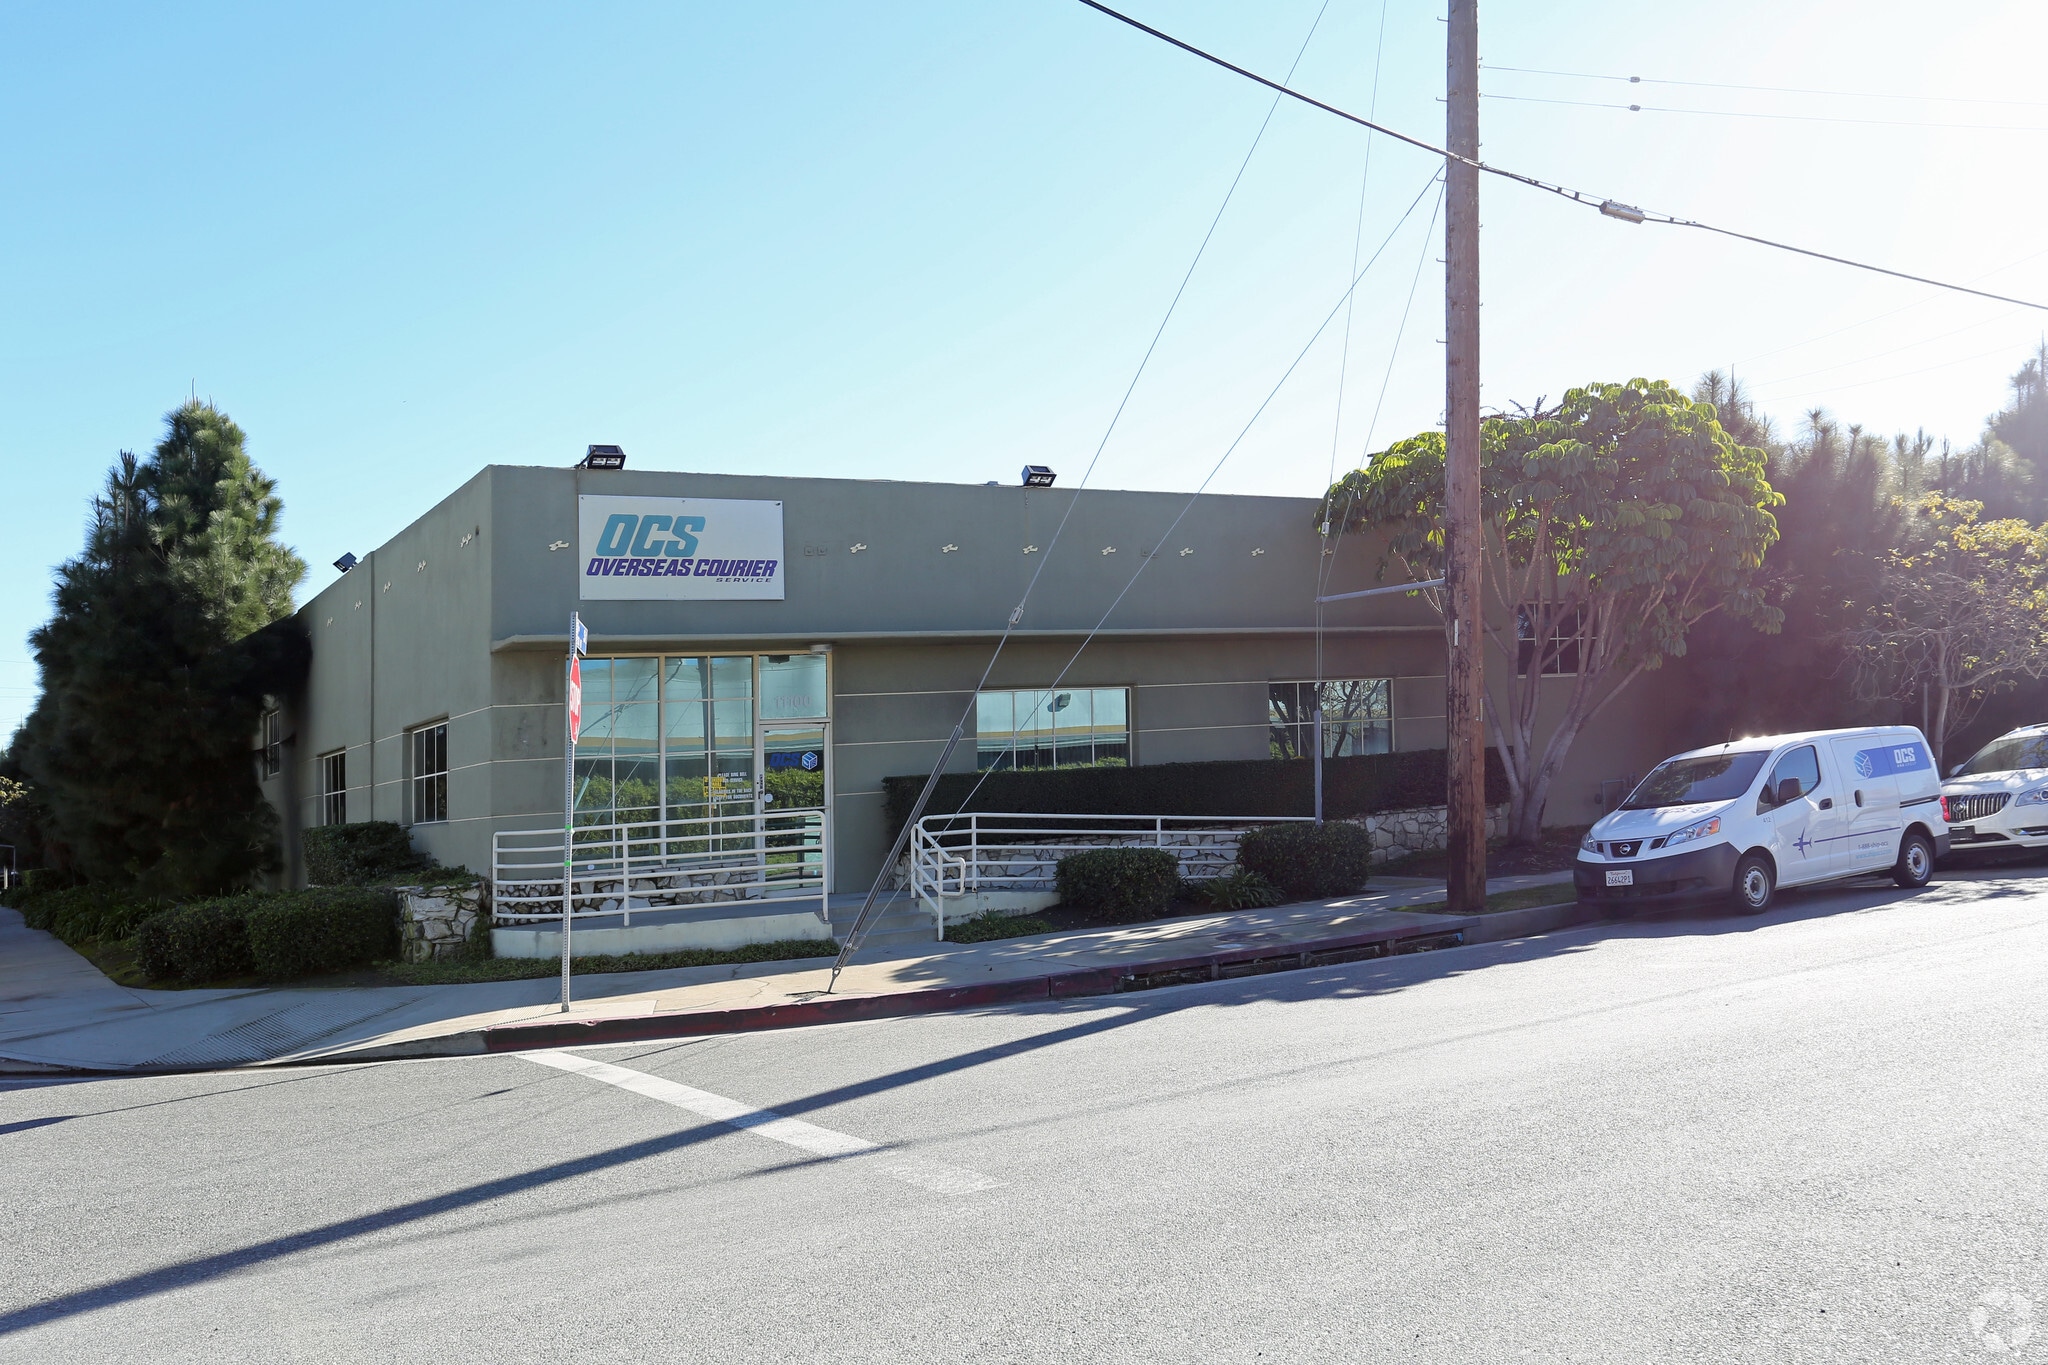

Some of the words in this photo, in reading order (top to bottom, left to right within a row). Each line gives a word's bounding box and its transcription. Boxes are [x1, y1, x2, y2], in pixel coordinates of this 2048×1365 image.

[596, 514, 706, 557] OCS
[586, 558, 694, 577] OVERSEAS
[693, 559, 778, 577] COURIER
[769, 752, 801, 767] OCS
[1893, 747, 1916, 764] OCS
